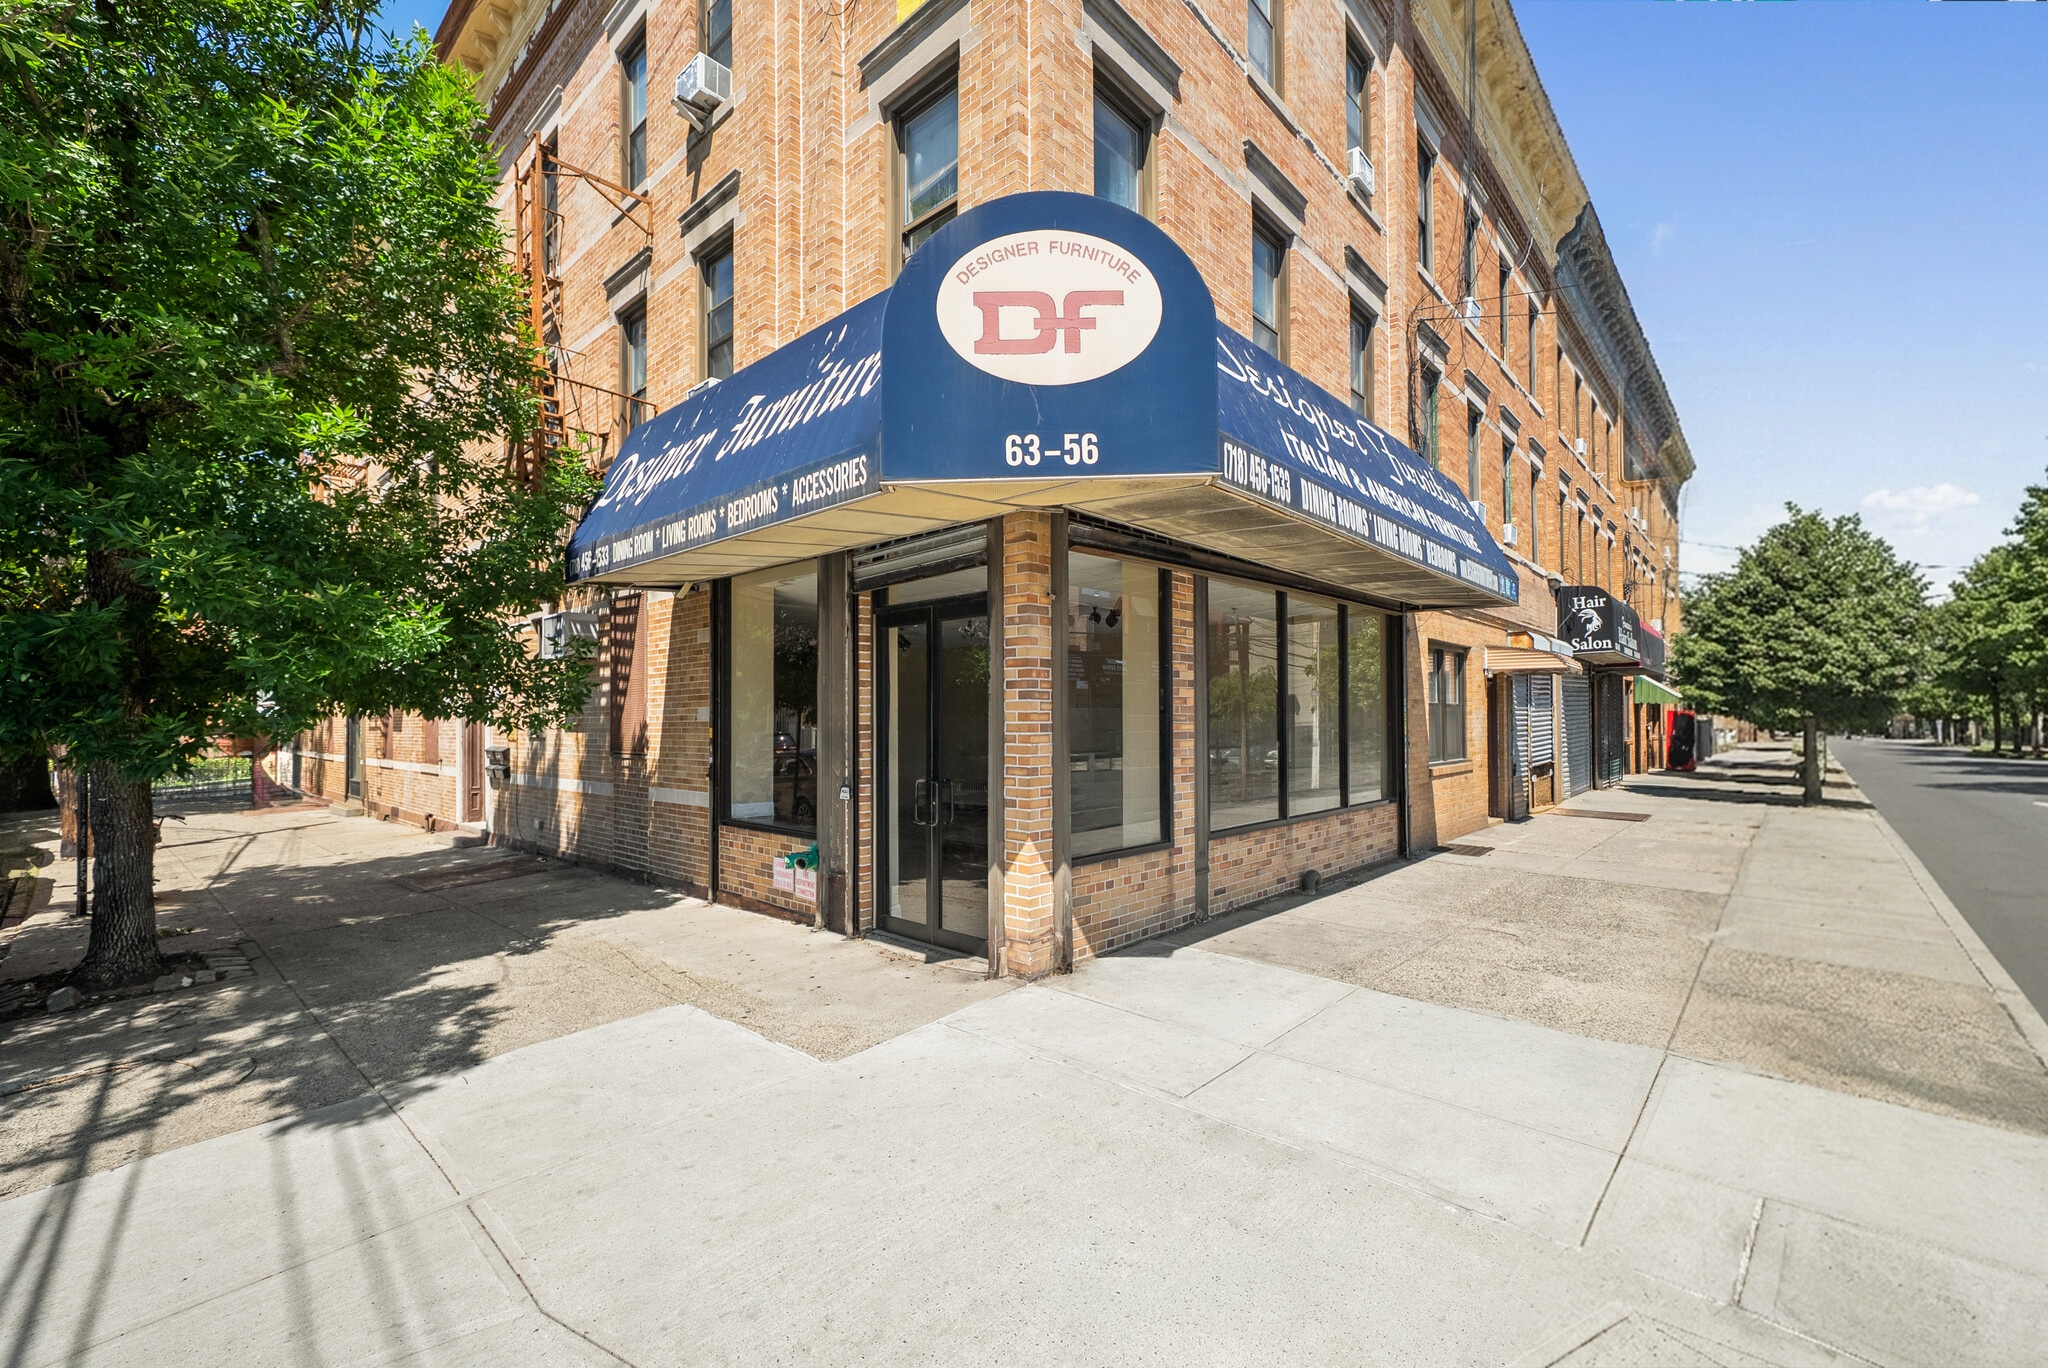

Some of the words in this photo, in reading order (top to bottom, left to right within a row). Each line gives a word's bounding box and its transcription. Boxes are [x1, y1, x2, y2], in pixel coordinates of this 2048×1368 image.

[956, 241, 1039, 285] DESIGNER
[1049, 240, 1142, 284] FURNITURE
[973, 290, 1124, 355] DF
[593, 428, 718, 506] Designer
[1005, 433, 1099, 466] 63-56
[1356, 419, 1476, 521] Furniture
[612, 538, 633, 563] DINING
[633, 529, 654, 557] ROOM
[661, 519, 686, 549] LIVING
[688, 509, 717, 540] ROOMS
[727, 485, 779, 529] BEDROOMS
[791, 454, 867, 507] ACCESSORIES
[1224, 442, 1248, 485] (718)
[1249, 453, 1291, 504] 456-1533
[1300, 477, 1337, 523] DINING
[1336, 495, 1369, 538] ROOMS
[1373, 514, 1399, 551] LIVING
[1399, 526, 1423, 561] ROOMS
[1426, 539, 1457, 575] BEDROOMS
[1280, 428, 1353, 489] ITALIAN
[1349, 467, 1370, 497] &
[1366, 476, 1432, 529] AMERICAN
[1425, 509, 1482, 554] FURNITURE
[1572, 595, 1607, 610] Hair
[1571, 637, 1612, 651] Salon
